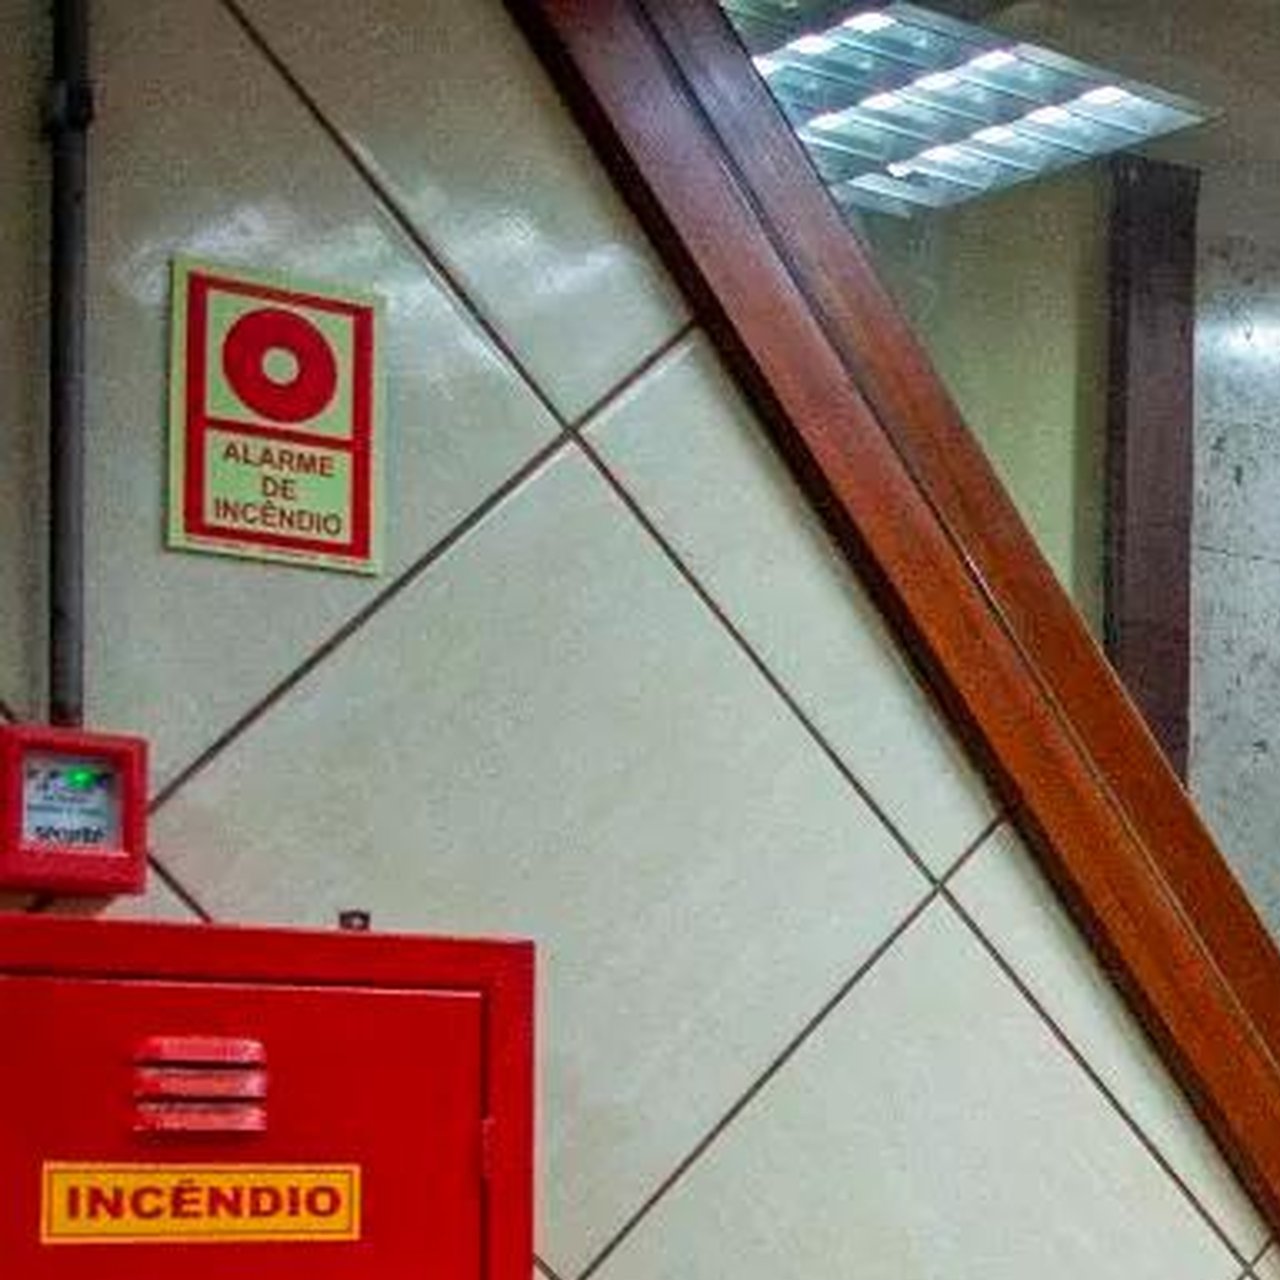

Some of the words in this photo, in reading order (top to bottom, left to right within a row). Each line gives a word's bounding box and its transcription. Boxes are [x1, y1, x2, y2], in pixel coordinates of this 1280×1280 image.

[223, 441, 335, 477] ALARME
[262, 475, 297, 500] DE
[214, 497, 342, 536] INCÊNDIO
[66, 1178, 343, 1219] INCÊNDIO
